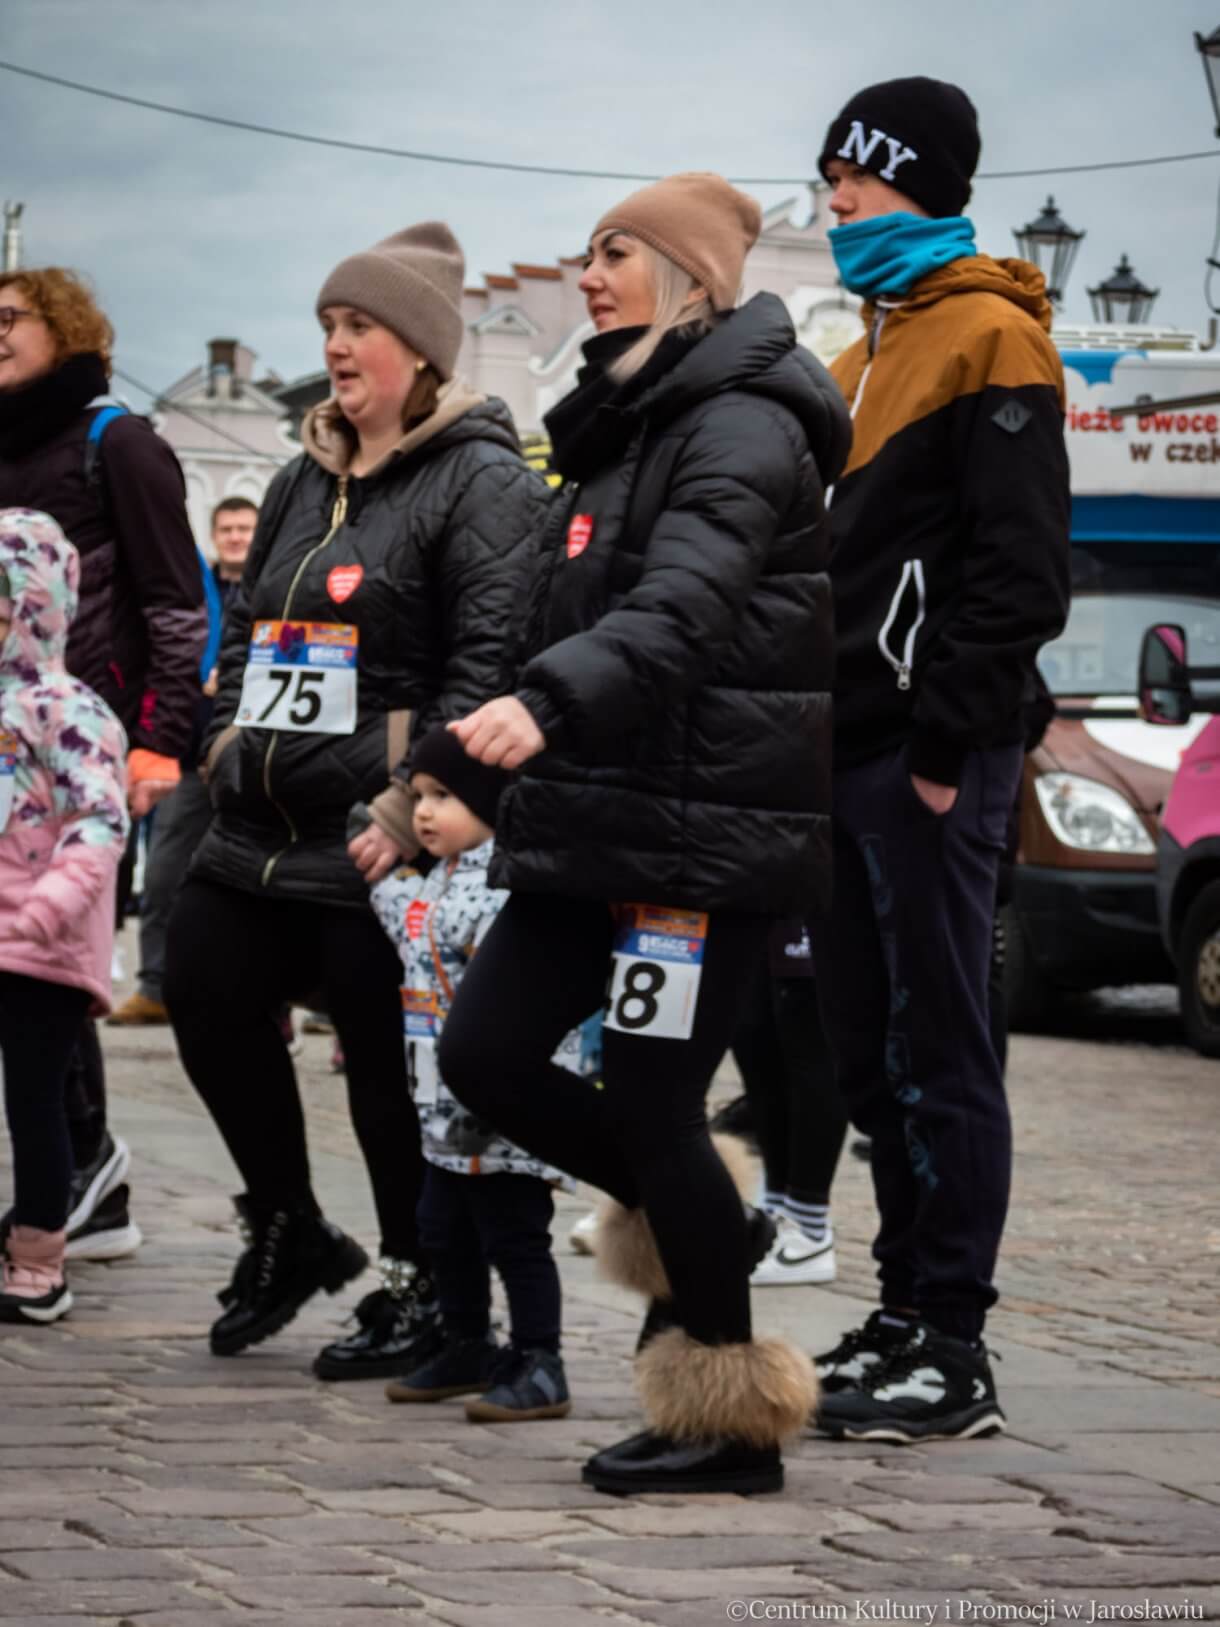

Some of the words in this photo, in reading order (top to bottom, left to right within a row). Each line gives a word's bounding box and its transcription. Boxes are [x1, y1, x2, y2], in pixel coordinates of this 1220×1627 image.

[837, 120, 918, 181] NY
[1067, 403, 1124, 432] ieże
[1138, 413, 1217, 432] owoce
[1130, 443, 1152, 462] w
[257, 670, 325, 726] 75
[607, 958, 666, 1029] 8
